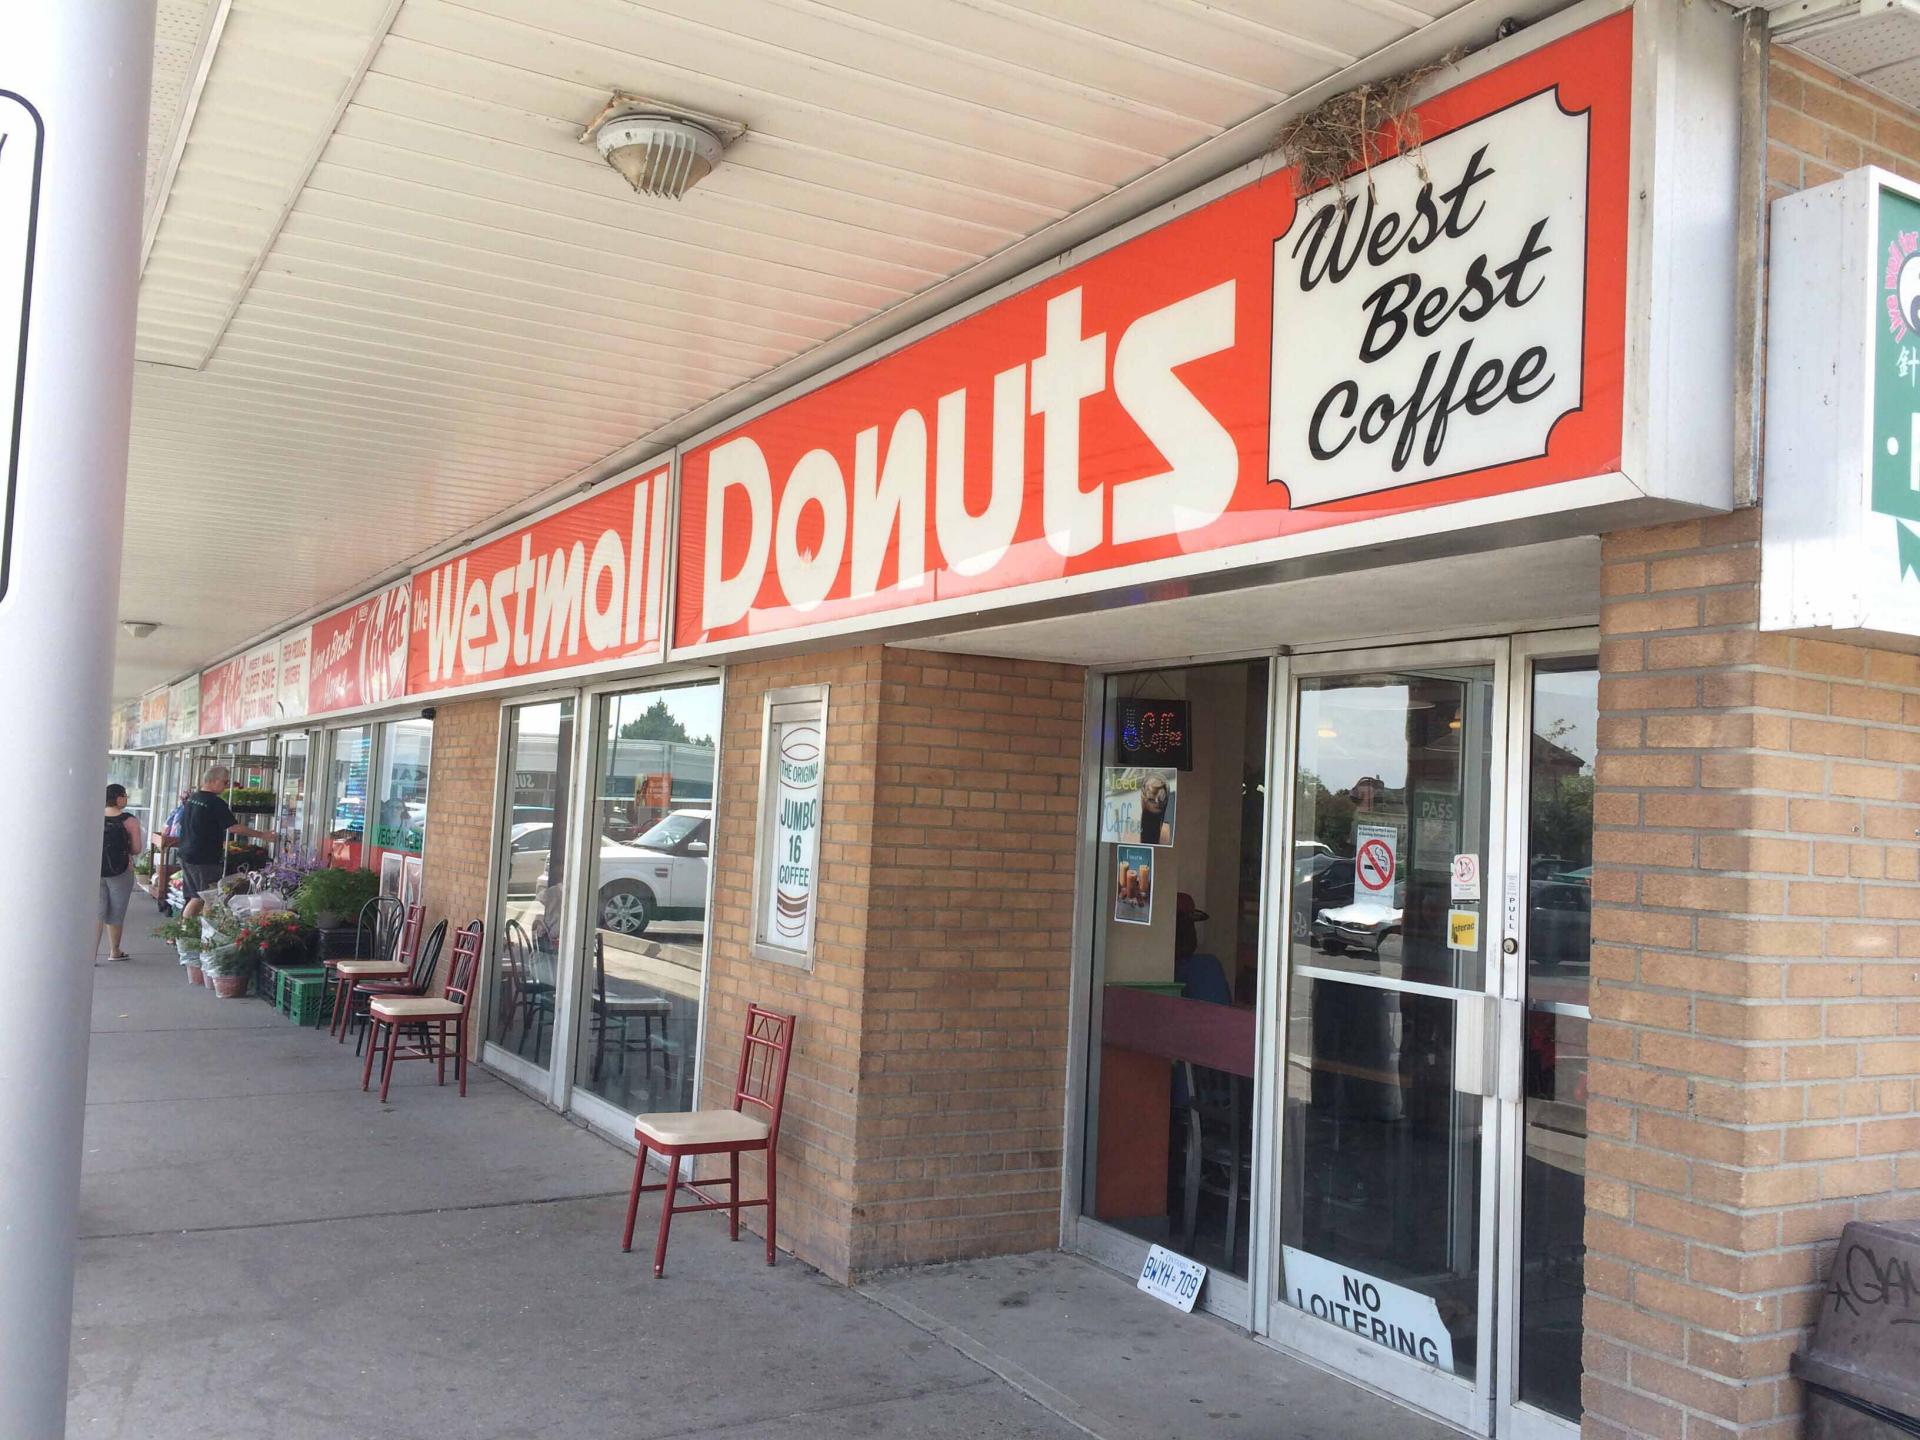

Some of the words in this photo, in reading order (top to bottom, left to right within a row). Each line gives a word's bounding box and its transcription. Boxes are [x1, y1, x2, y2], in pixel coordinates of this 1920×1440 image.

[1291, 143, 1496, 292] West
[1358, 216, 1553, 364] Best
[1308, 337, 1556, 473] Coffee
[428, 470, 669, 684] Westmall
[702, 278, 1239, 631] Donuts
[1111, 773, 1138, 791] Iced
[1422, 800, 1454, 819] PASS
[788, 834, 802, 863] 16
[778, 864, 810, 888] COFFEE
[1508, 897, 1516, 930] PULL
[1342, 1274, 1381, 1313] NO
